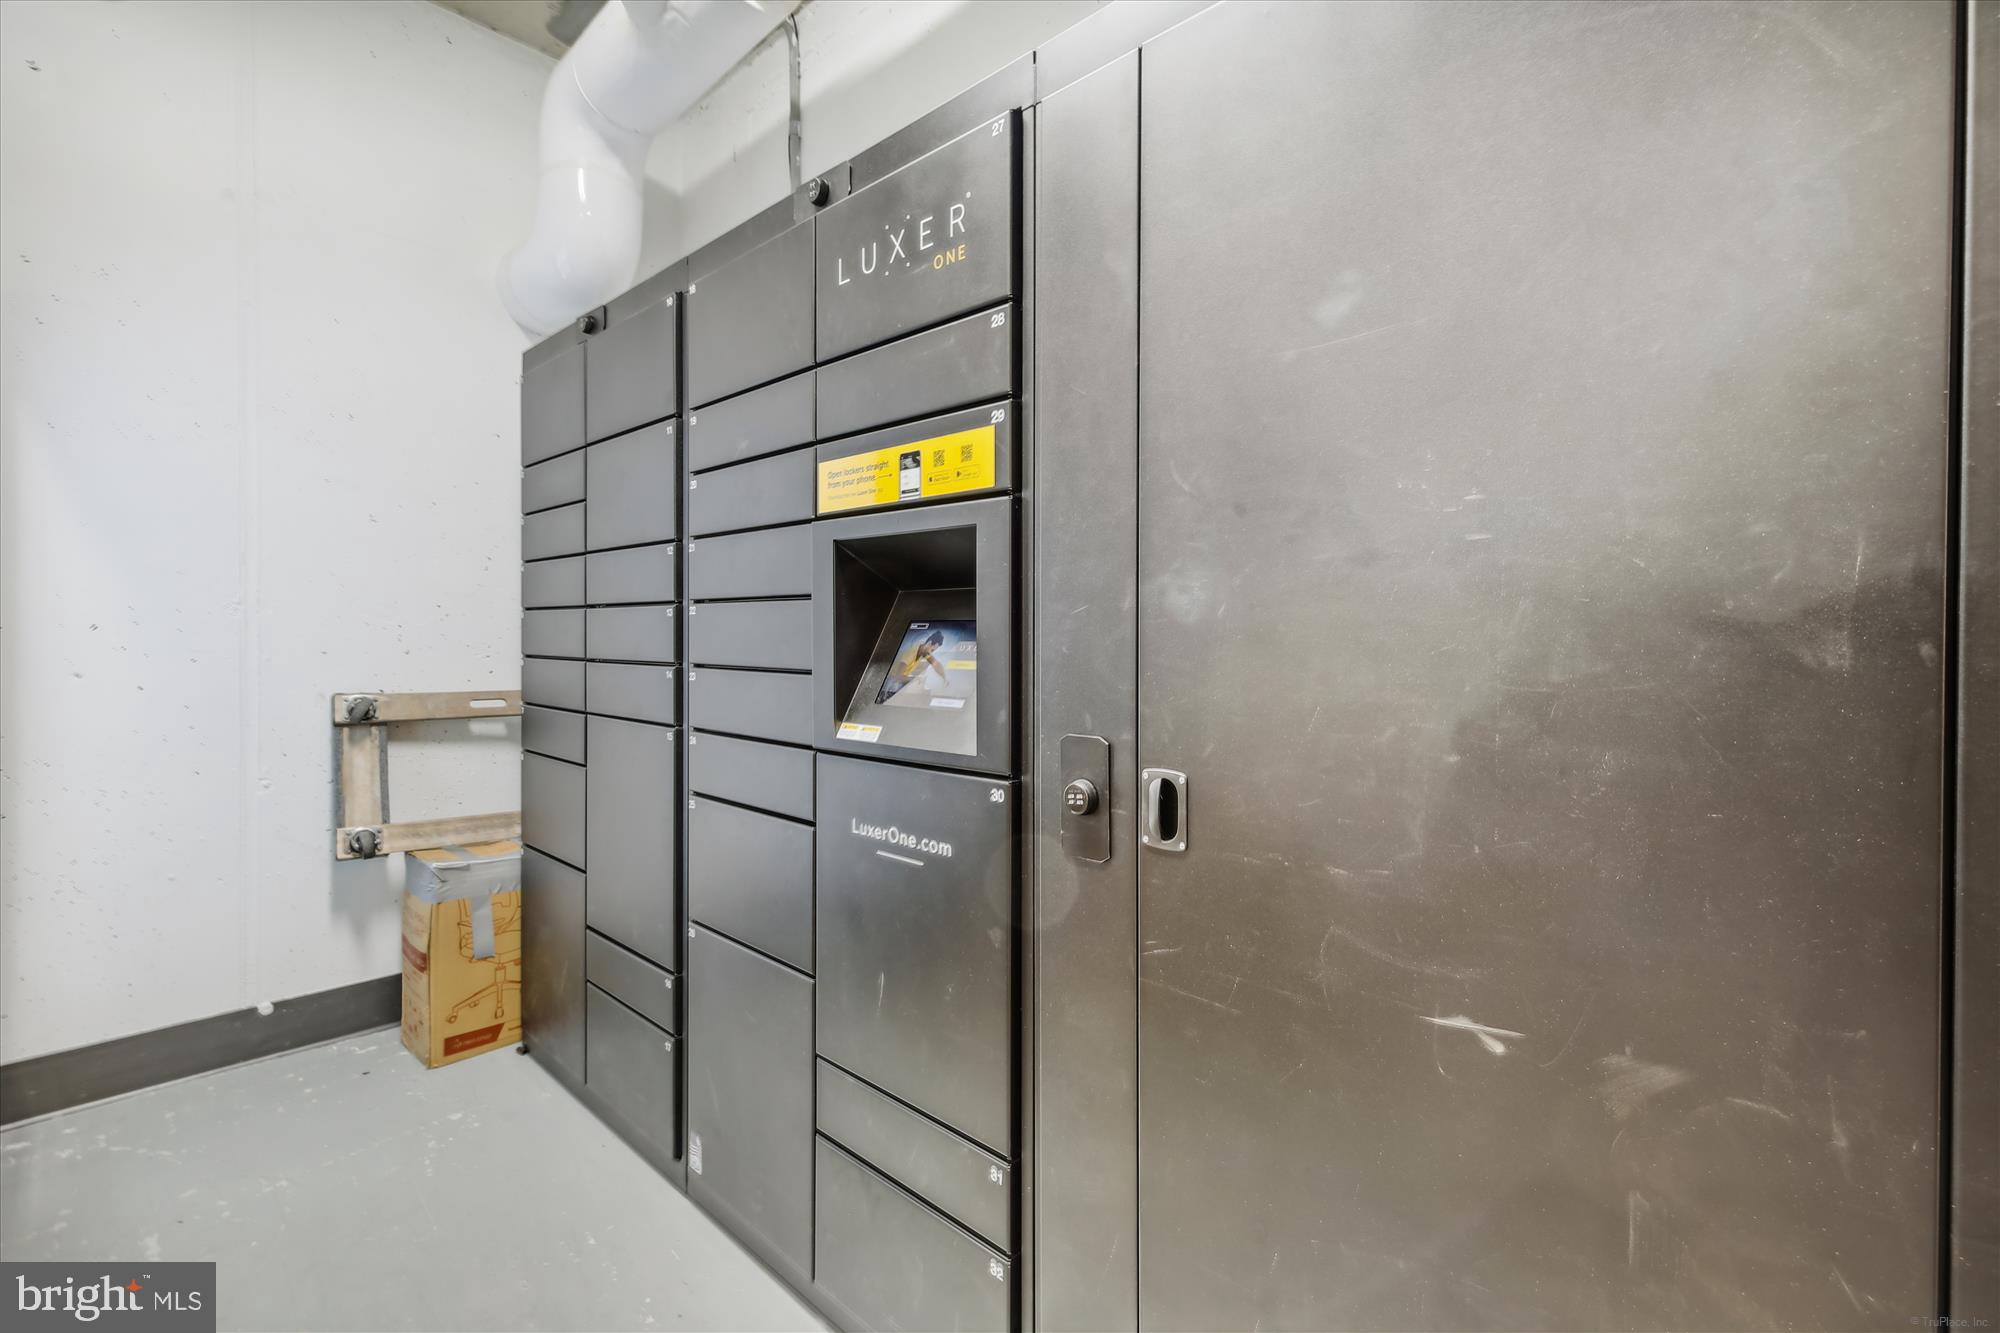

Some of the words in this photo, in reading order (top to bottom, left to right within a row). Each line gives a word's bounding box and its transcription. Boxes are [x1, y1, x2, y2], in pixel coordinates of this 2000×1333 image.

[991, 118, 1005, 137] 27
[838, 203, 966, 286] LUXER
[933, 244, 966, 270] ONE
[991, 312, 1005, 328] 28
[991, 408, 1005, 424] 29
[828, 471, 842, 480] Open
[844, 466, 865, 476] lockers
[865, 461, 889, 472] straight
[842, 479, 855, 488] your
[856, 474, 876, 486] phone
[990, 788, 1005, 803] 30
[851, 817, 952, 858] LuxerOne.com
